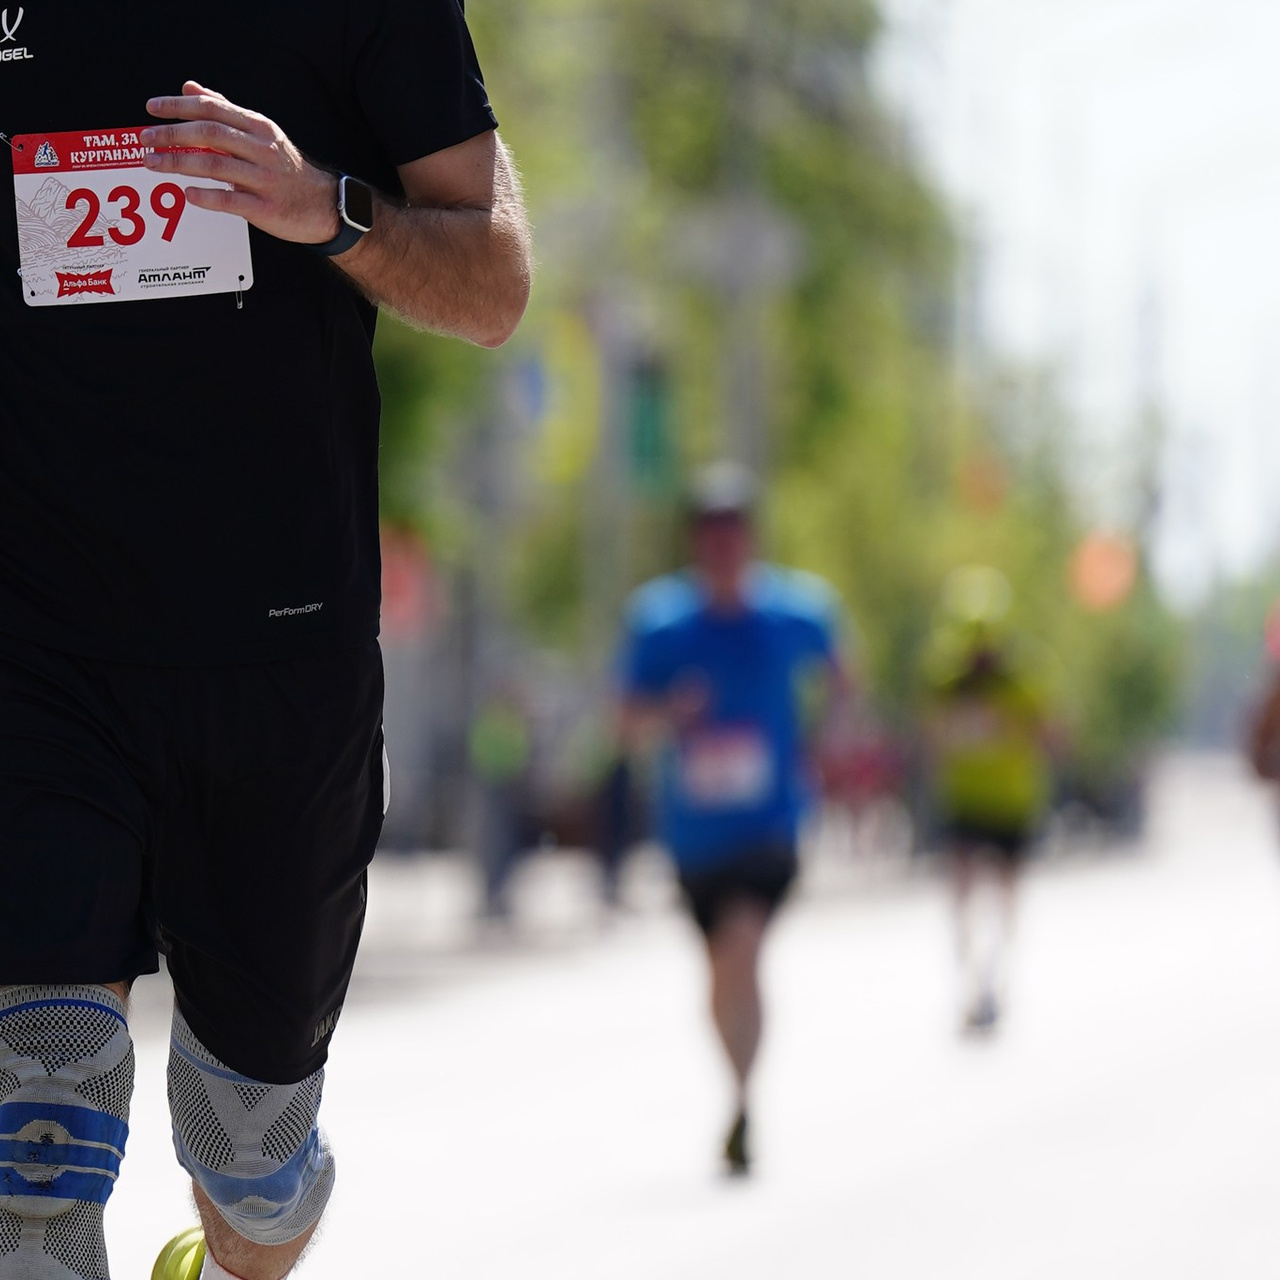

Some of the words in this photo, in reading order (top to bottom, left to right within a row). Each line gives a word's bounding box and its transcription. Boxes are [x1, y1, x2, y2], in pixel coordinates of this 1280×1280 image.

[83, 134, 119, 148] ТАМ,
[121, 133, 139, 145] ЗА
[65, 182, 186, 248] 239
[88, 278, 107, 286] Банк
